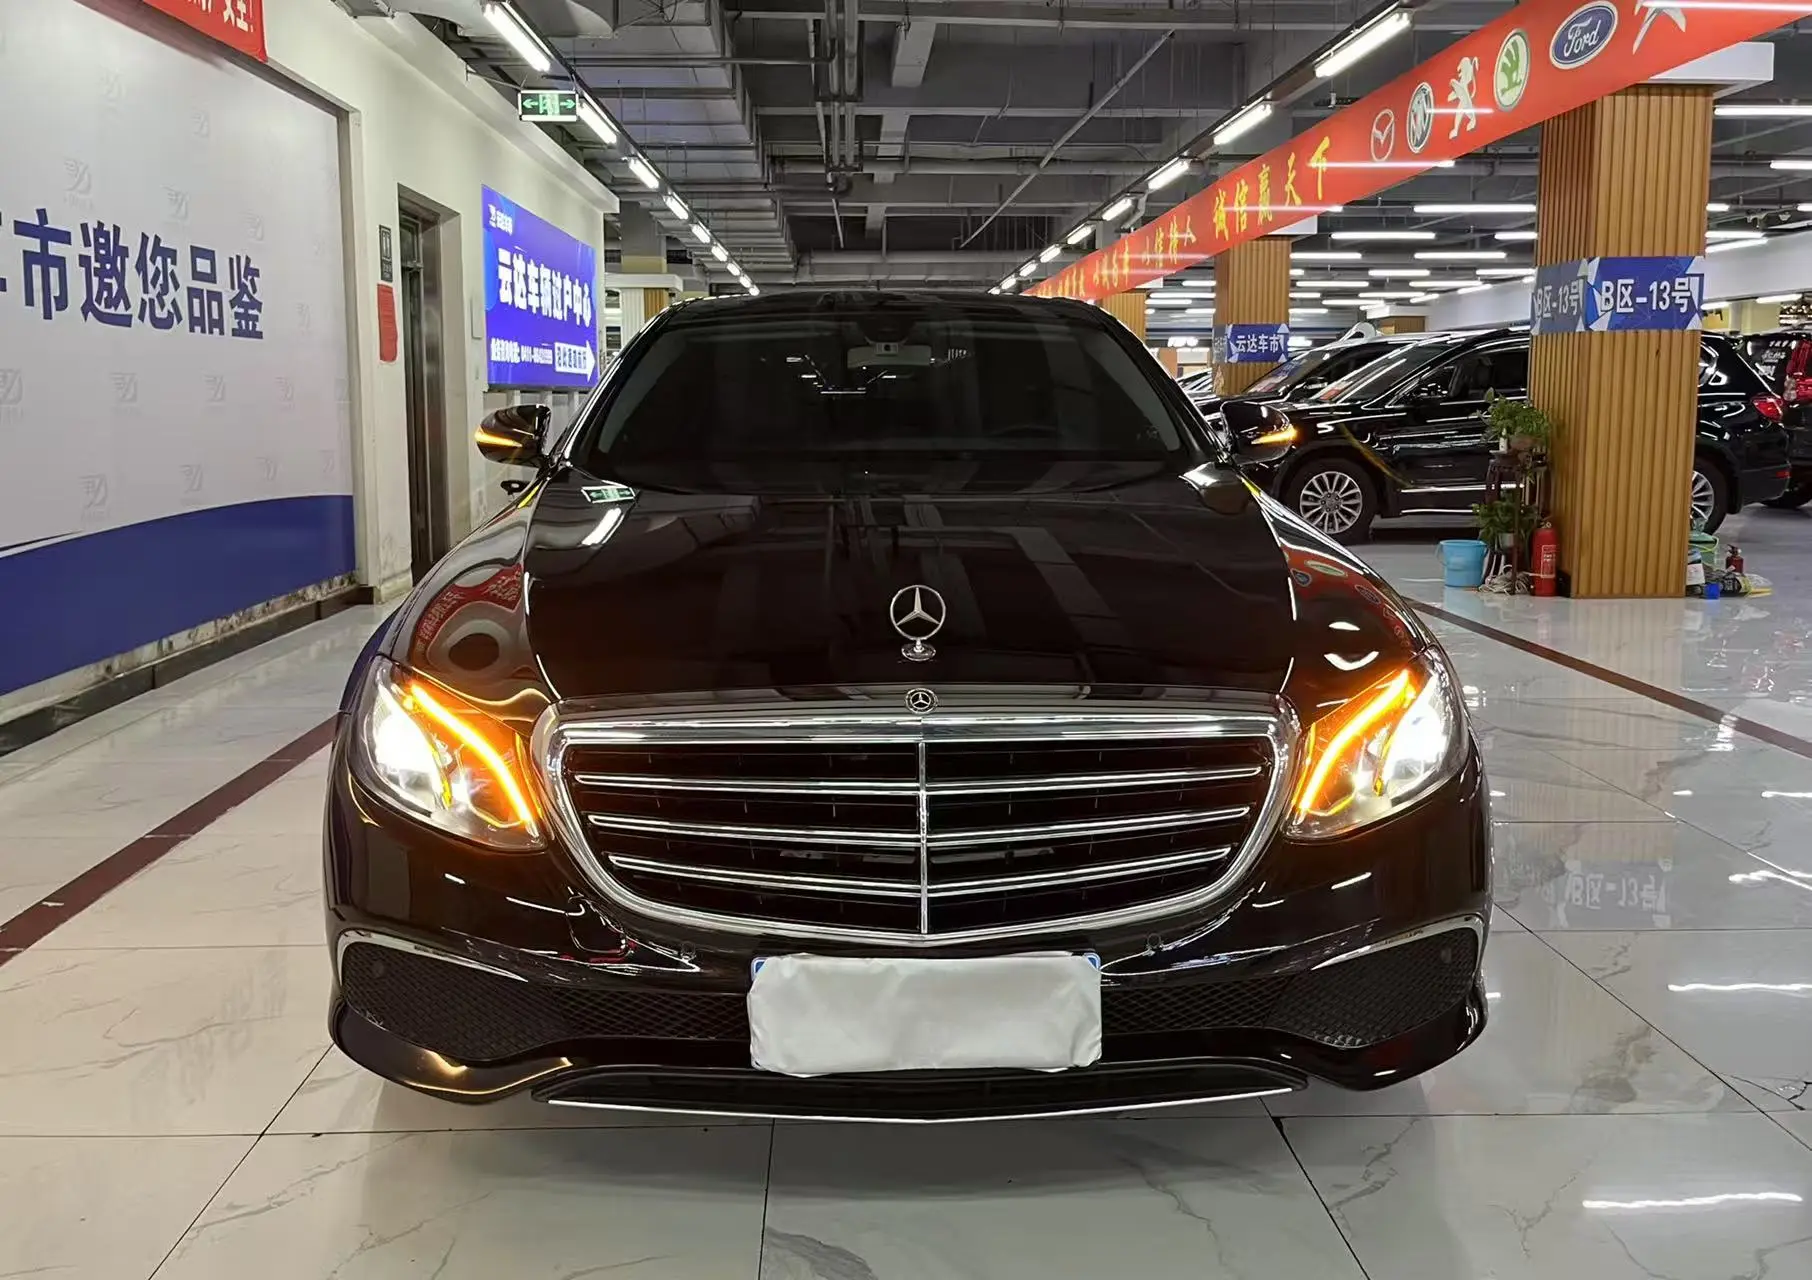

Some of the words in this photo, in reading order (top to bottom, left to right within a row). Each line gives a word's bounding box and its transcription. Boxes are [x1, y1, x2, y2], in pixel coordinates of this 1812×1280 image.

[1563, 15, 1600, 57] Ford
[1213, 135, 1331, 241] 诚信赢天下
[0, 208, 264, 340] 市邀您品鉴
[498, 247, 592, 328] 云达车辆过户中心
[1600, 276, 1692, 313] B区-13号
[1535, 281, 1581, 320] B区-13号
[1235, 333, 1280, 353] 云达车市
